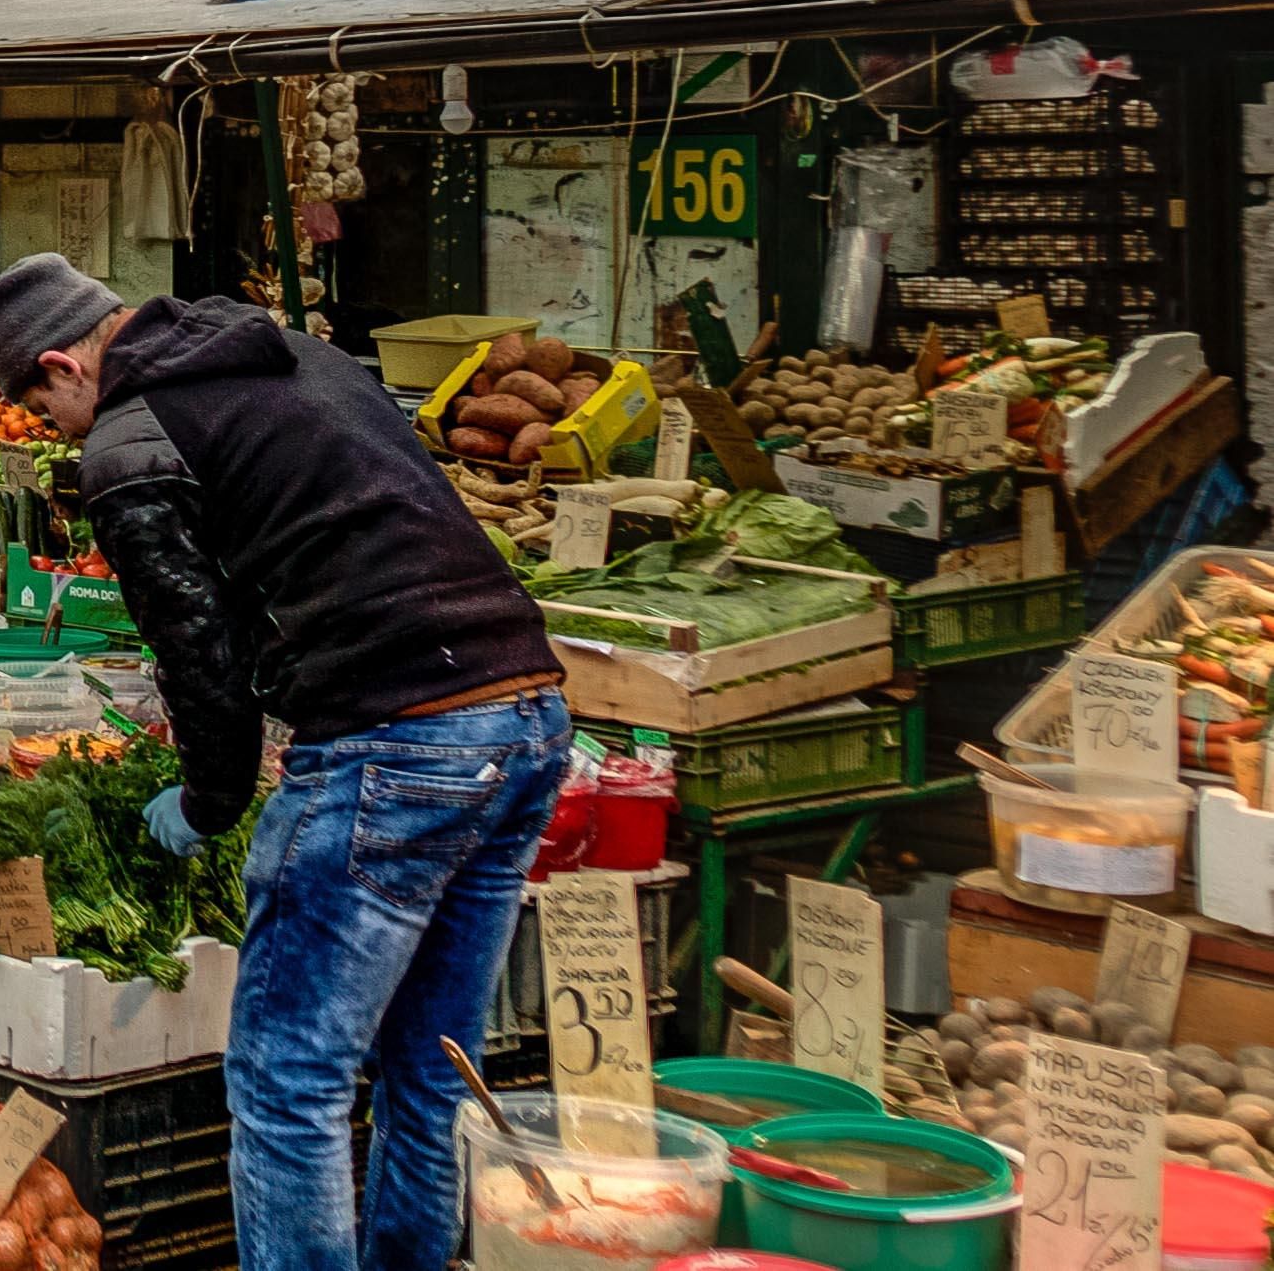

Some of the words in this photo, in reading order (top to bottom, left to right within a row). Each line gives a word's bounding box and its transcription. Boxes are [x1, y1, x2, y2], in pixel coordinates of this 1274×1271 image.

[637, 148, 746, 223] 156
[69, 585, 99, 599] ROMA
[554, 985, 602, 1076] 3
[595, 986, 633, 1017] 50
[796, 961, 834, 1057] 8
[1028, 1149, 1092, 1231] 21
